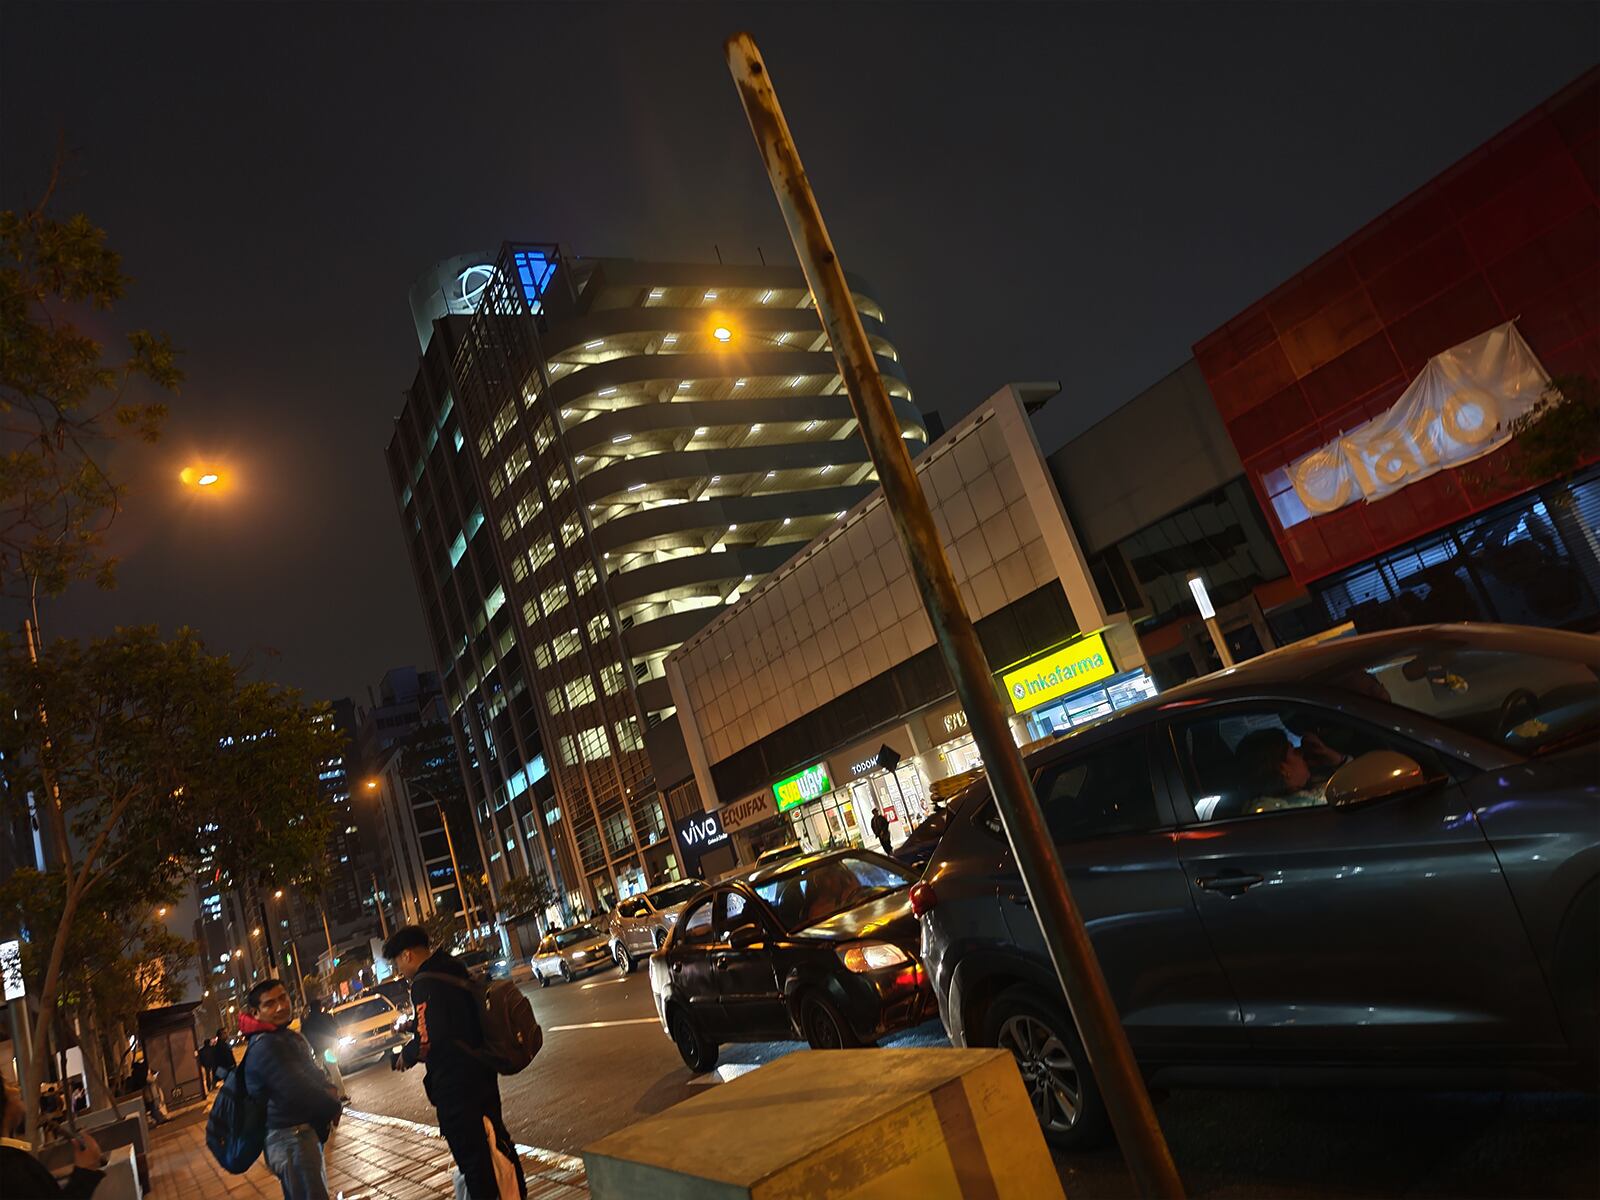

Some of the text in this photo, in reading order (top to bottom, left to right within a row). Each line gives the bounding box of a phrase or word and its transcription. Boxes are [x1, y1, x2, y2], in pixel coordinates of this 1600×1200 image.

[778, 764, 824, 808] SUBWAY
[721, 794, 767, 826] EQUIFAX
[682, 818, 717, 845] vivo
